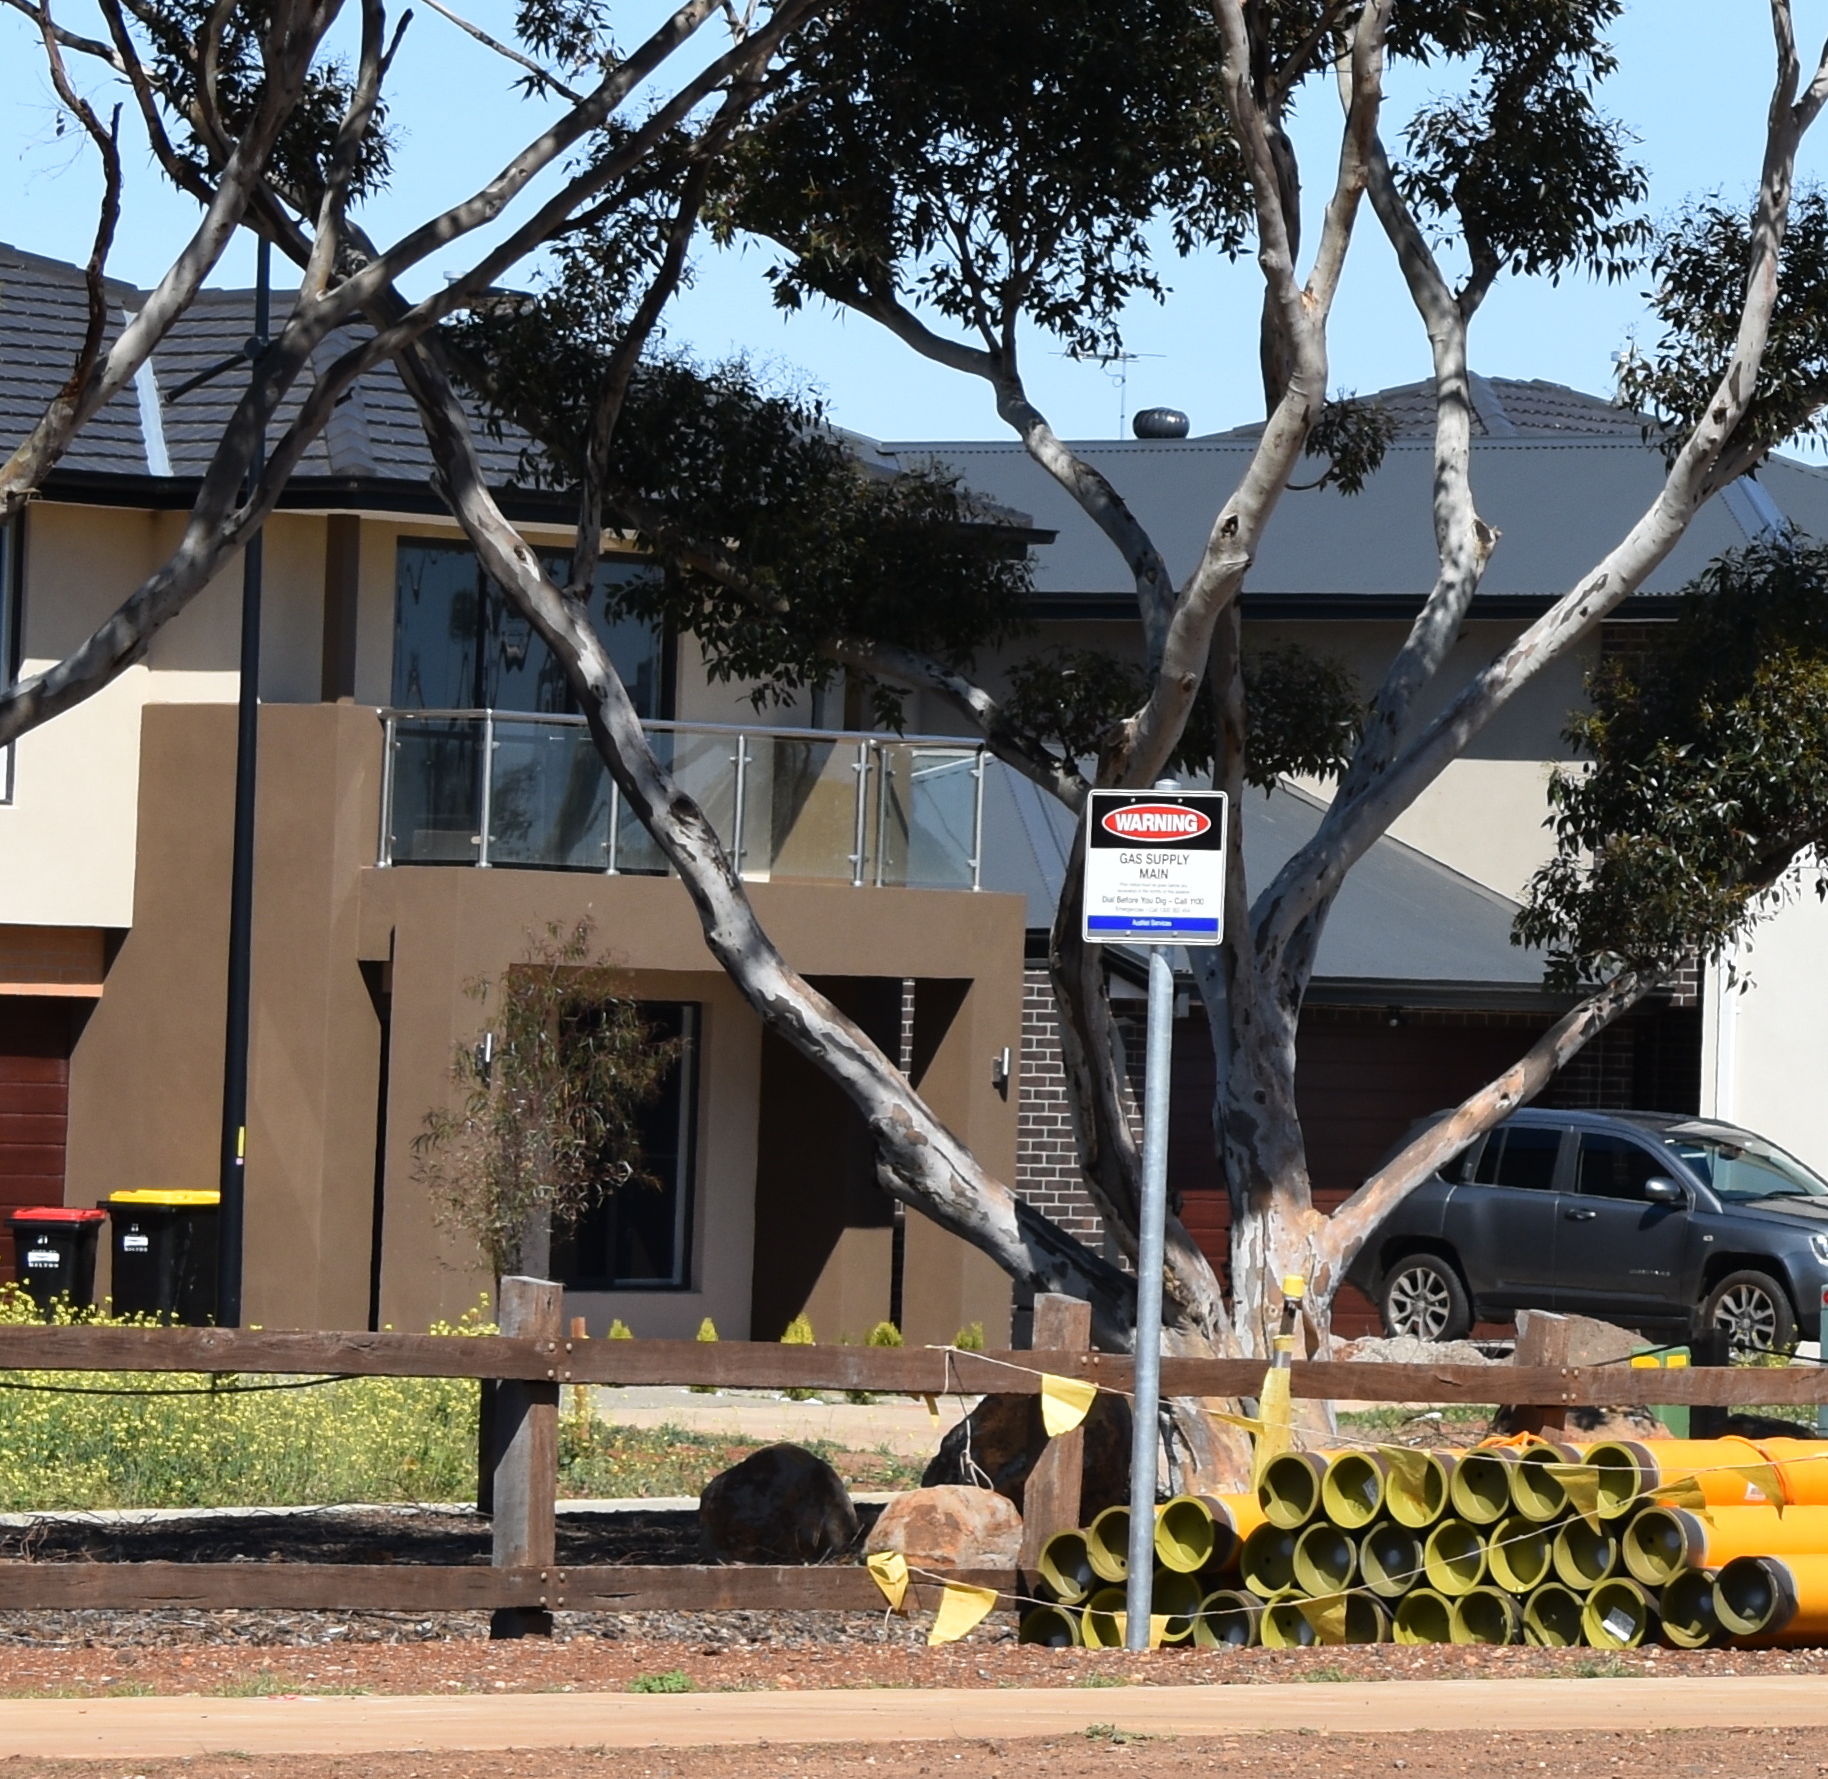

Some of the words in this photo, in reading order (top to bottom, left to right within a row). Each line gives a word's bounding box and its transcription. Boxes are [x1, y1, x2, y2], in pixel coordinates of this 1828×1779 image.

[1114, 813, 1198, 832] WARNING
[1119, 853, 1143, 865] GAS
[1146, 853, 1190, 866] SUPPLY
[1139, 868, 1169, 880] MAIN
[1102, 895, 1115, 903] Dial
[1117, 896, 1139, 904] Before
[1141, 896, 1153, 904] You
[1155, 896, 1167, 906] Dig
[1174, 897, 1188, 905] Call
